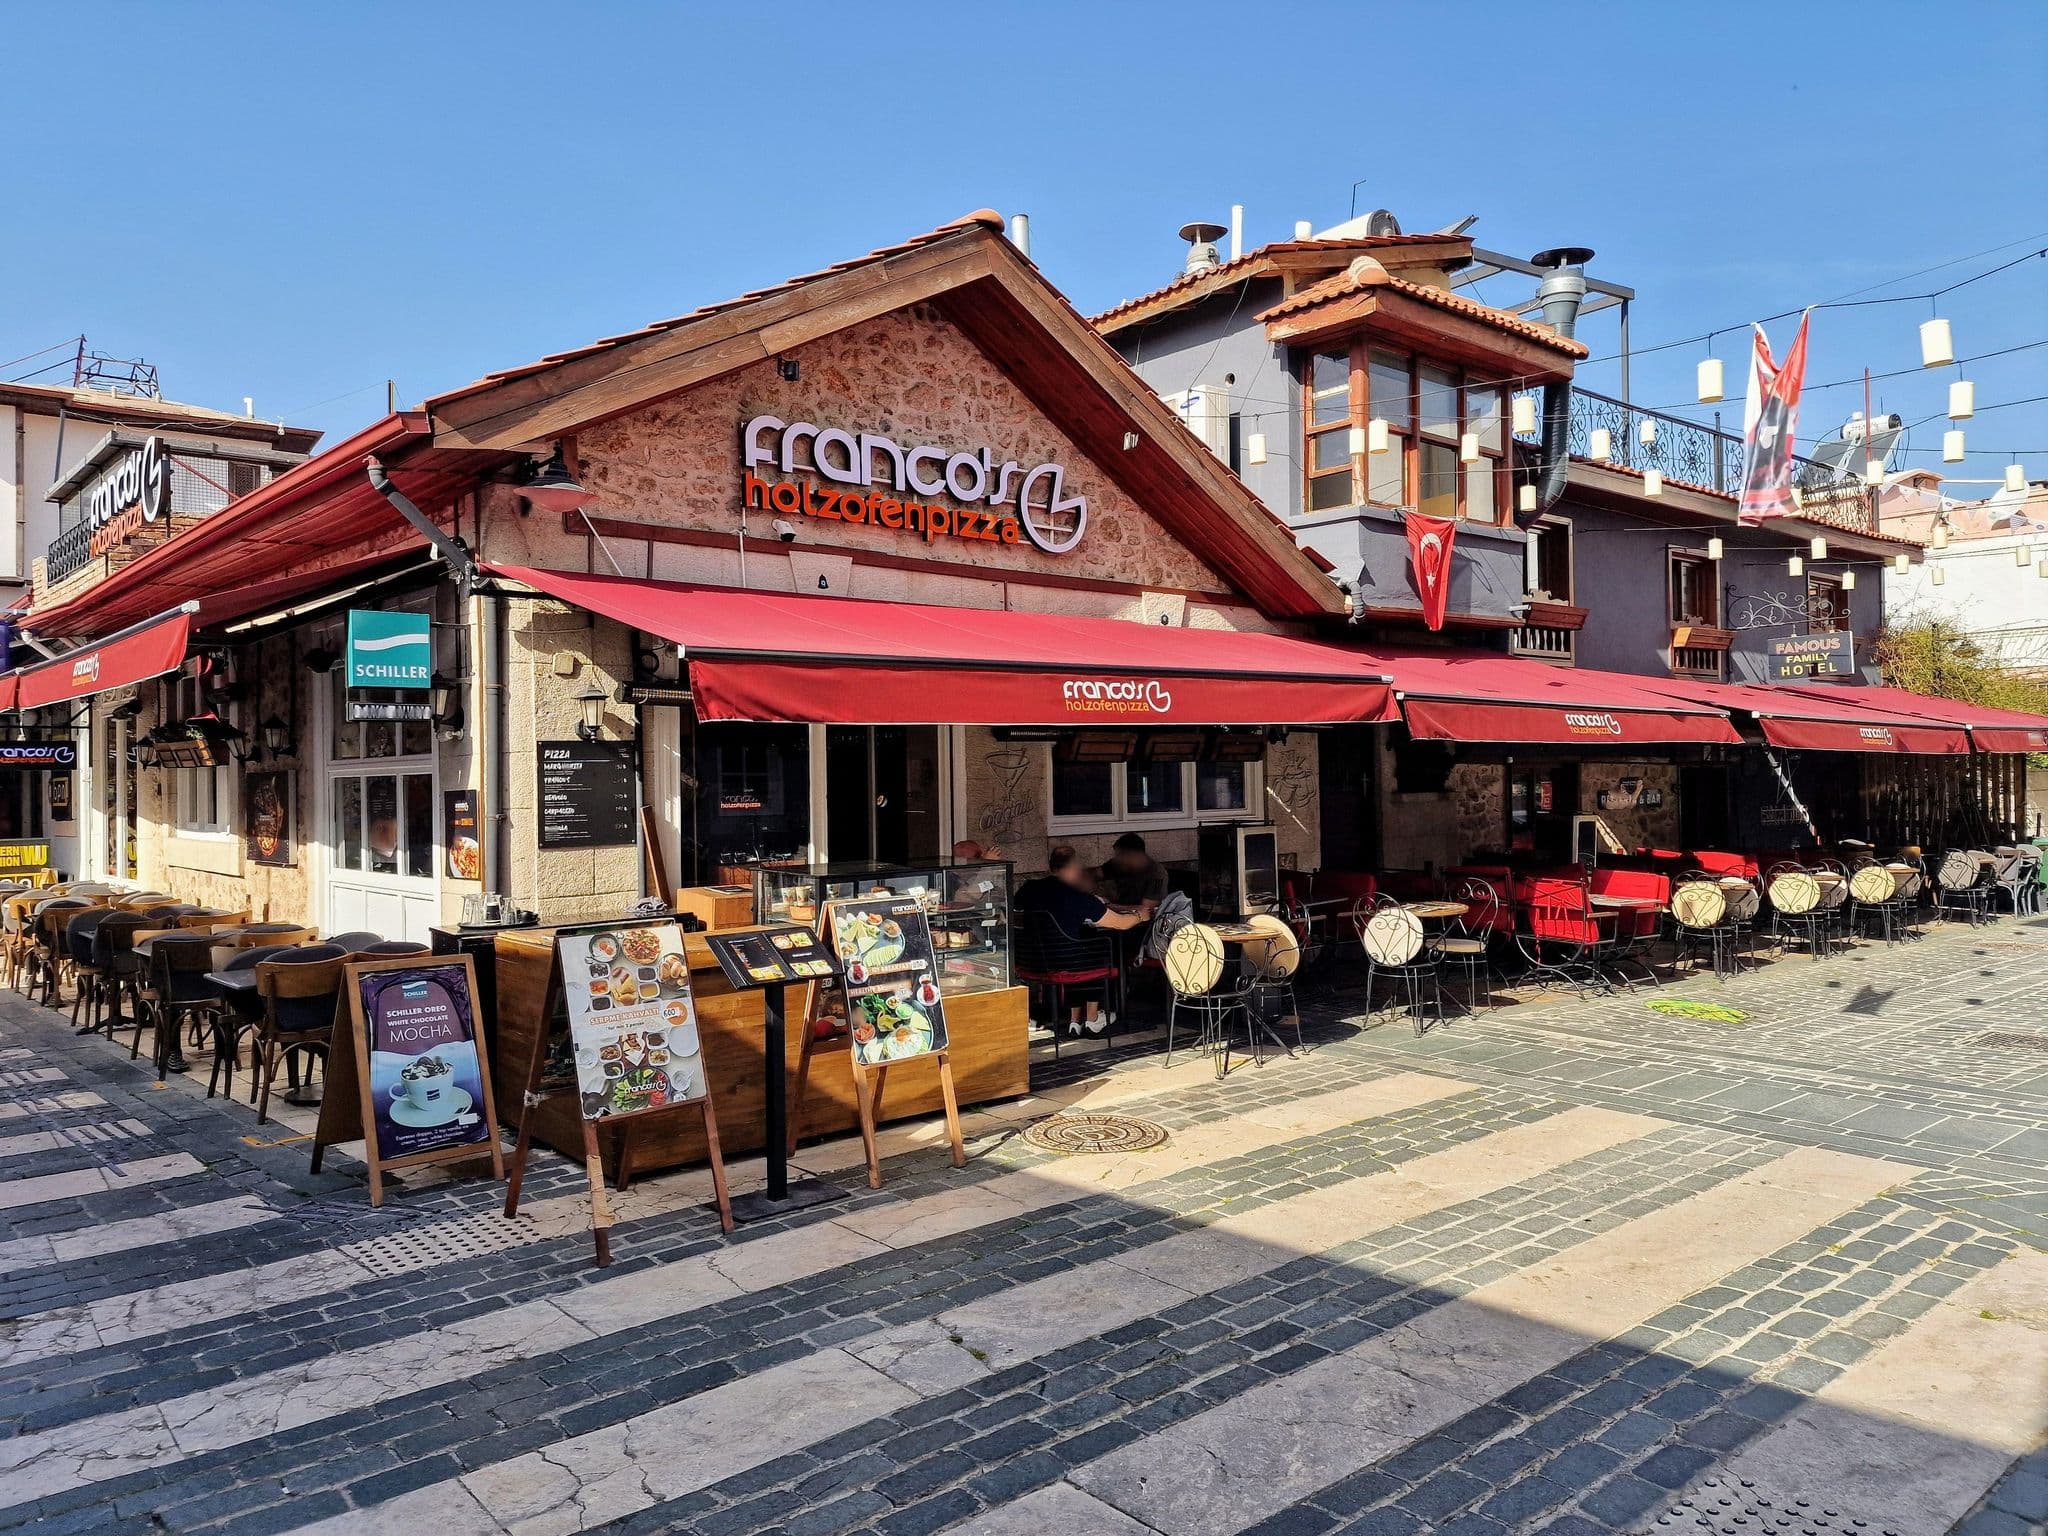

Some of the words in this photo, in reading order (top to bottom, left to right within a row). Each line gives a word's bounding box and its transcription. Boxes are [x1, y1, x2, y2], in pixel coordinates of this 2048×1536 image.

[745, 471, 1019, 544] holzofenpizza
[1775, 637, 1841, 654] FAMOUS
[1786, 652, 1831, 664] FAMILY
[356, 664, 428, 679] SCHILLER
[1781, 662, 1838, 676] HOTEL
[1065, 699, 1150, 713] holzofenpizza
[544, 750, 570, 759] PIZZA
[386, 1007, 423, 1018] SCHILLER
[424, 1005, 447, 1013] OREO
[387, 1019, 409, 1027] WHITE
[410, 1015, 449, 1024] CHOCOLATE
[590, 1014, 621, 1026] SERPME
[390, 1024, 452, 1043] MOCHA
